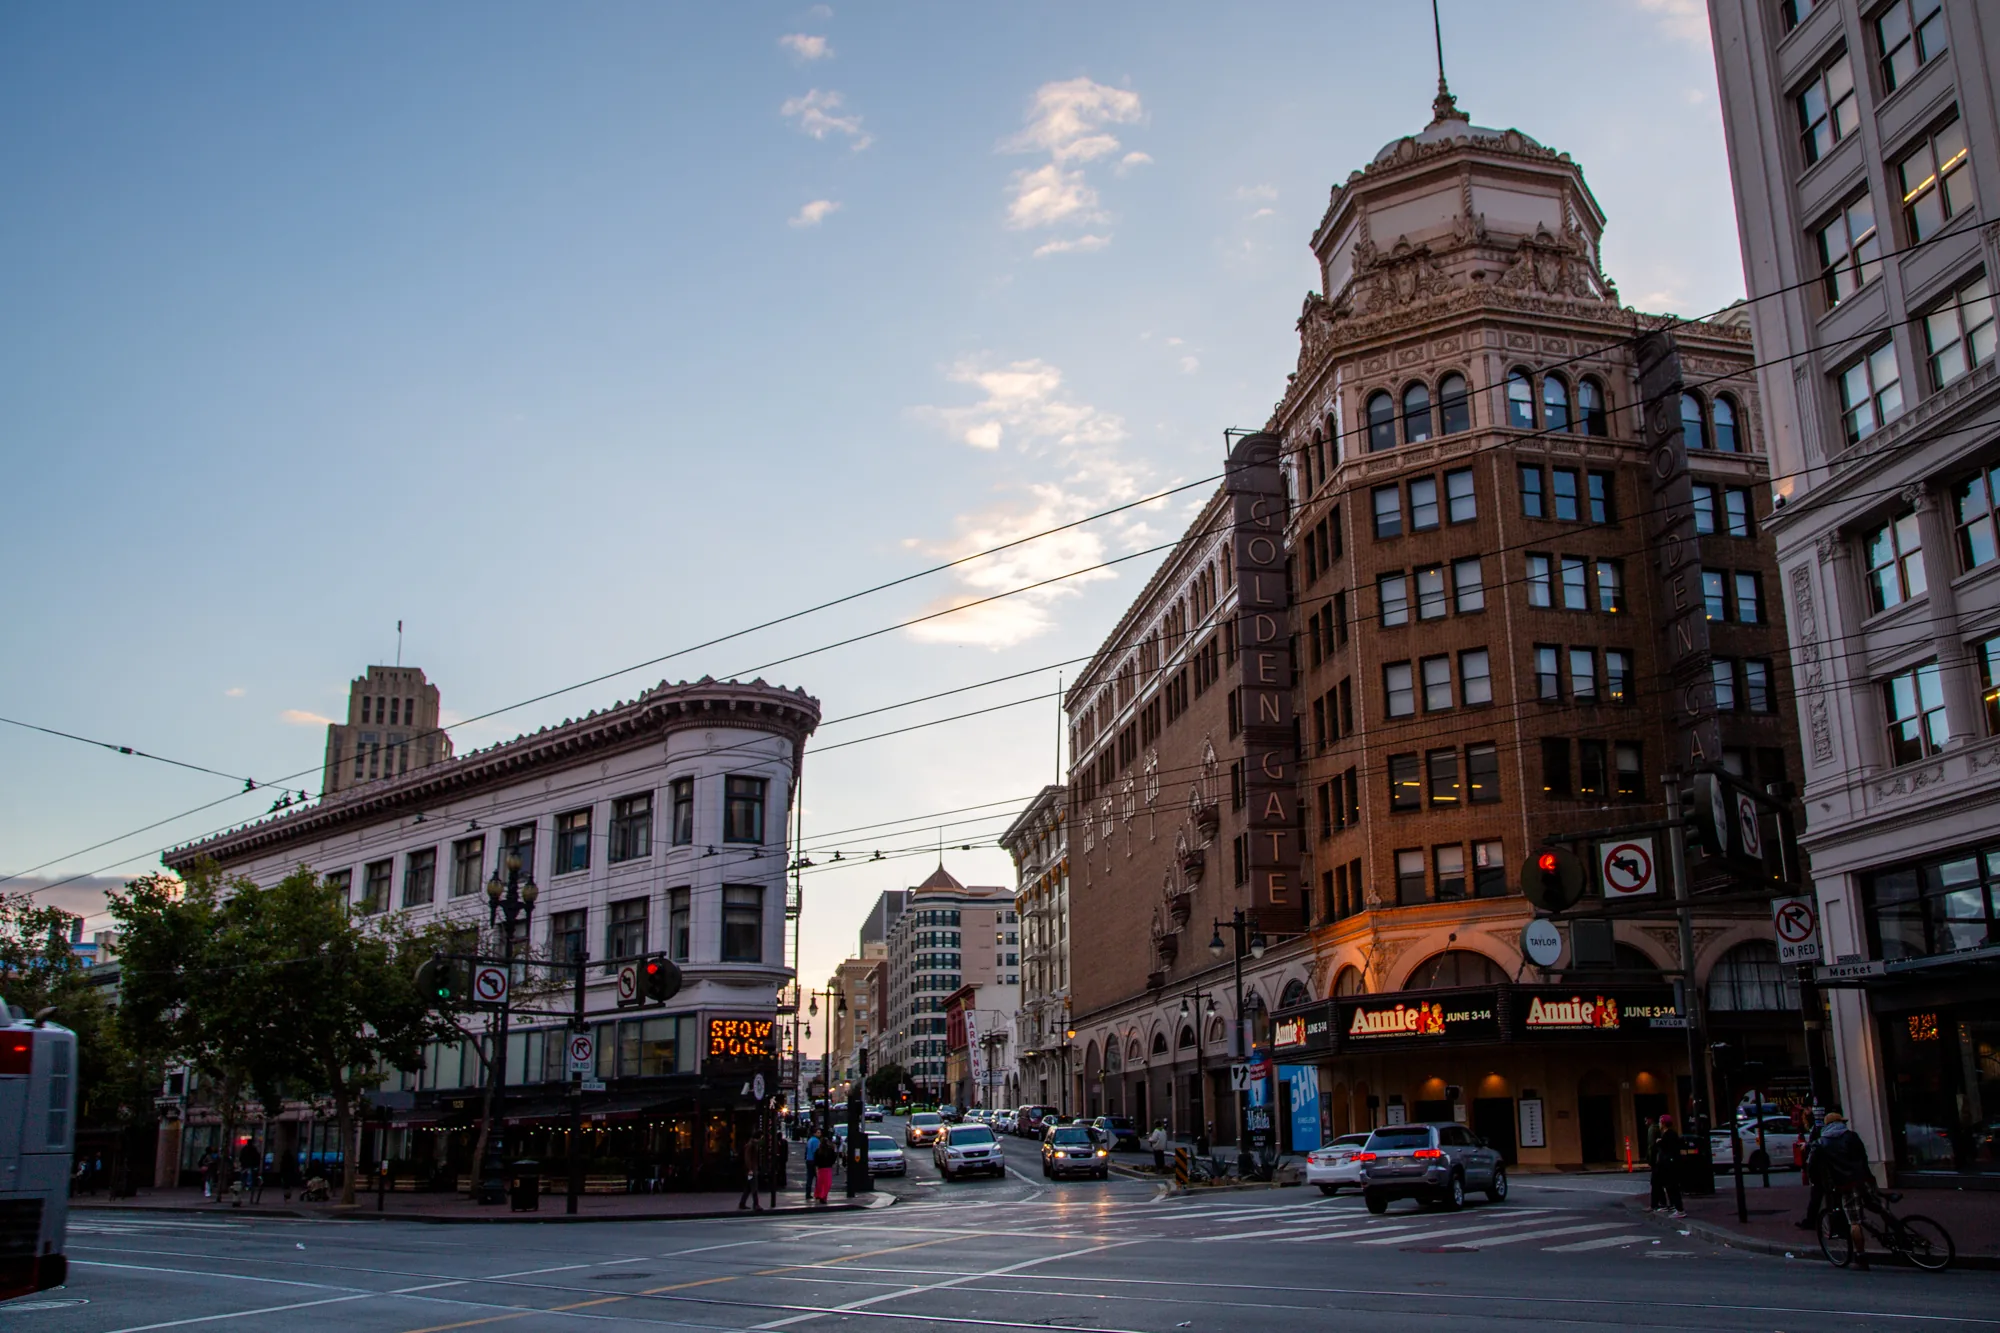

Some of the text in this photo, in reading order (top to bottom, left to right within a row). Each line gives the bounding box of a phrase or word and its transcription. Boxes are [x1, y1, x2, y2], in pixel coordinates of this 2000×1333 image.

[1653, 400, 1694, 656] GOLDEN
[1247, 496, 1288, 905] GOLDEN GATE
[1530, 938, 1557, 947] TAYLOR
[1783, 943, 1816, 958] ON RED
[1829, 965, 1872, 977] Market
[1349, 1003, 1420, 1035] Annie
[1445, 1009, 1492, 1023] JUNE 3-14
[1526, 996, 1594, 1025] Annie
[1624, 1006, 1651, 1018] JUNE
[1653, 1006, 1677, 1018] 3-14
[711, 1020, 772, 1038] SHOW
[1274, 1019, 1298, 1047] Annie
[1307, 1020, 1327, 1035] JUNE 3-14
[967, 1012, 980, 1076] PARKING
[1247, 1108, 1270, 1131] Matilda
